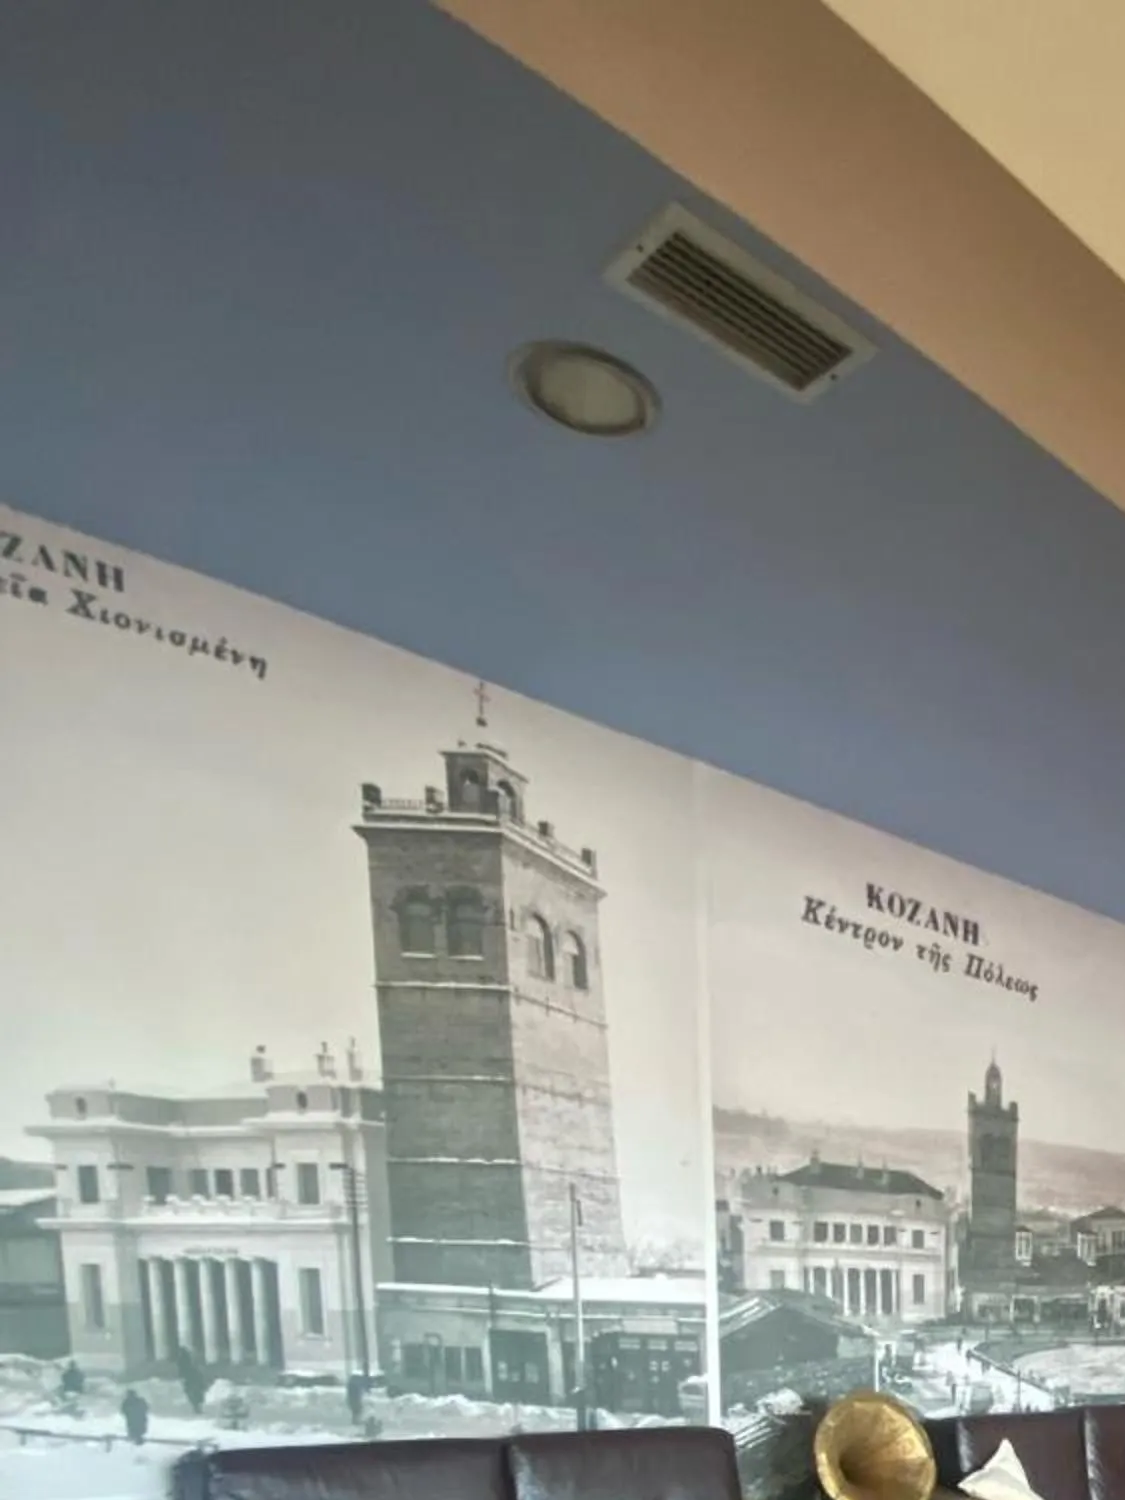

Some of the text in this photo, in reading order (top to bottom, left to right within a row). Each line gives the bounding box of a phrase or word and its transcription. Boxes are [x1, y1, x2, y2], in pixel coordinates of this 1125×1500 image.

[65, 587, 268, 680] Χιονισμένη
[801, 895, 904, 949] Κέντρον
[963, 952, 1038, 1002] Πόλεως
[866, 882, 980, 946] ΚΟΖΑΝΗ
